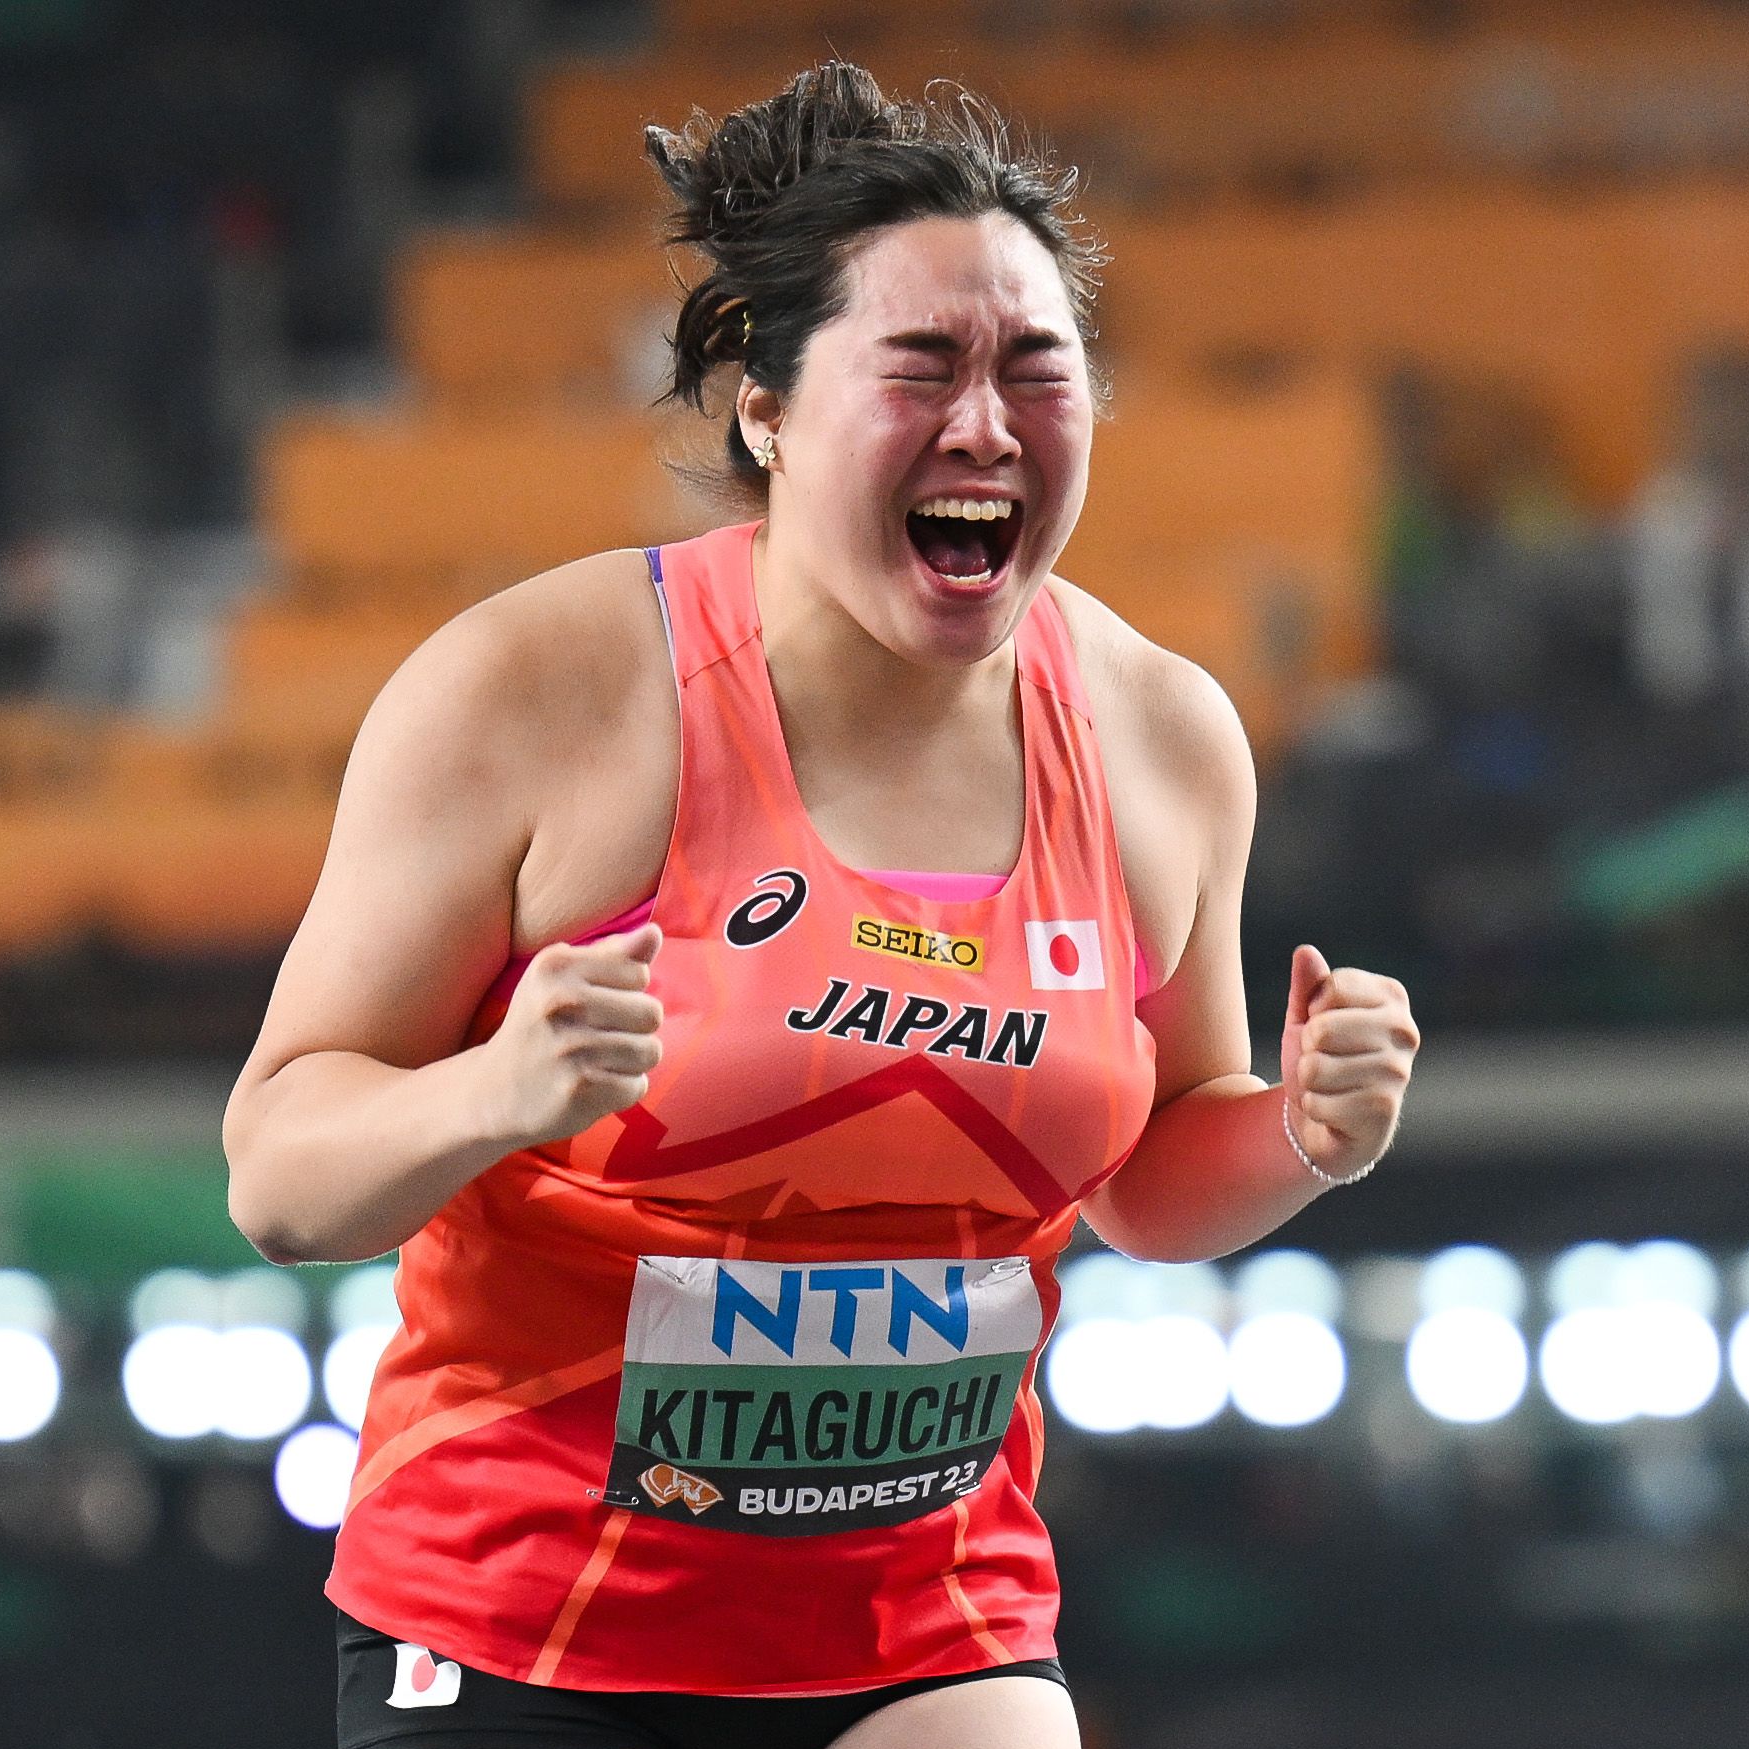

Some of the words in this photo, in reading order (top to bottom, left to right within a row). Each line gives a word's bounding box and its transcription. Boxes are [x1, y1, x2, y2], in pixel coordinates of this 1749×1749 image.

[856, 920, 979, 967] SEIKO
[786, 977, 1049, 1069] JAPAN
[711, 1265, 969, 1359] NTN
[638, 1374, 1002, 1461] KITAGUCHI
[738, 1470, 940, 1515] BUDAPEST
[940, 1460, 978, 1492] 23
